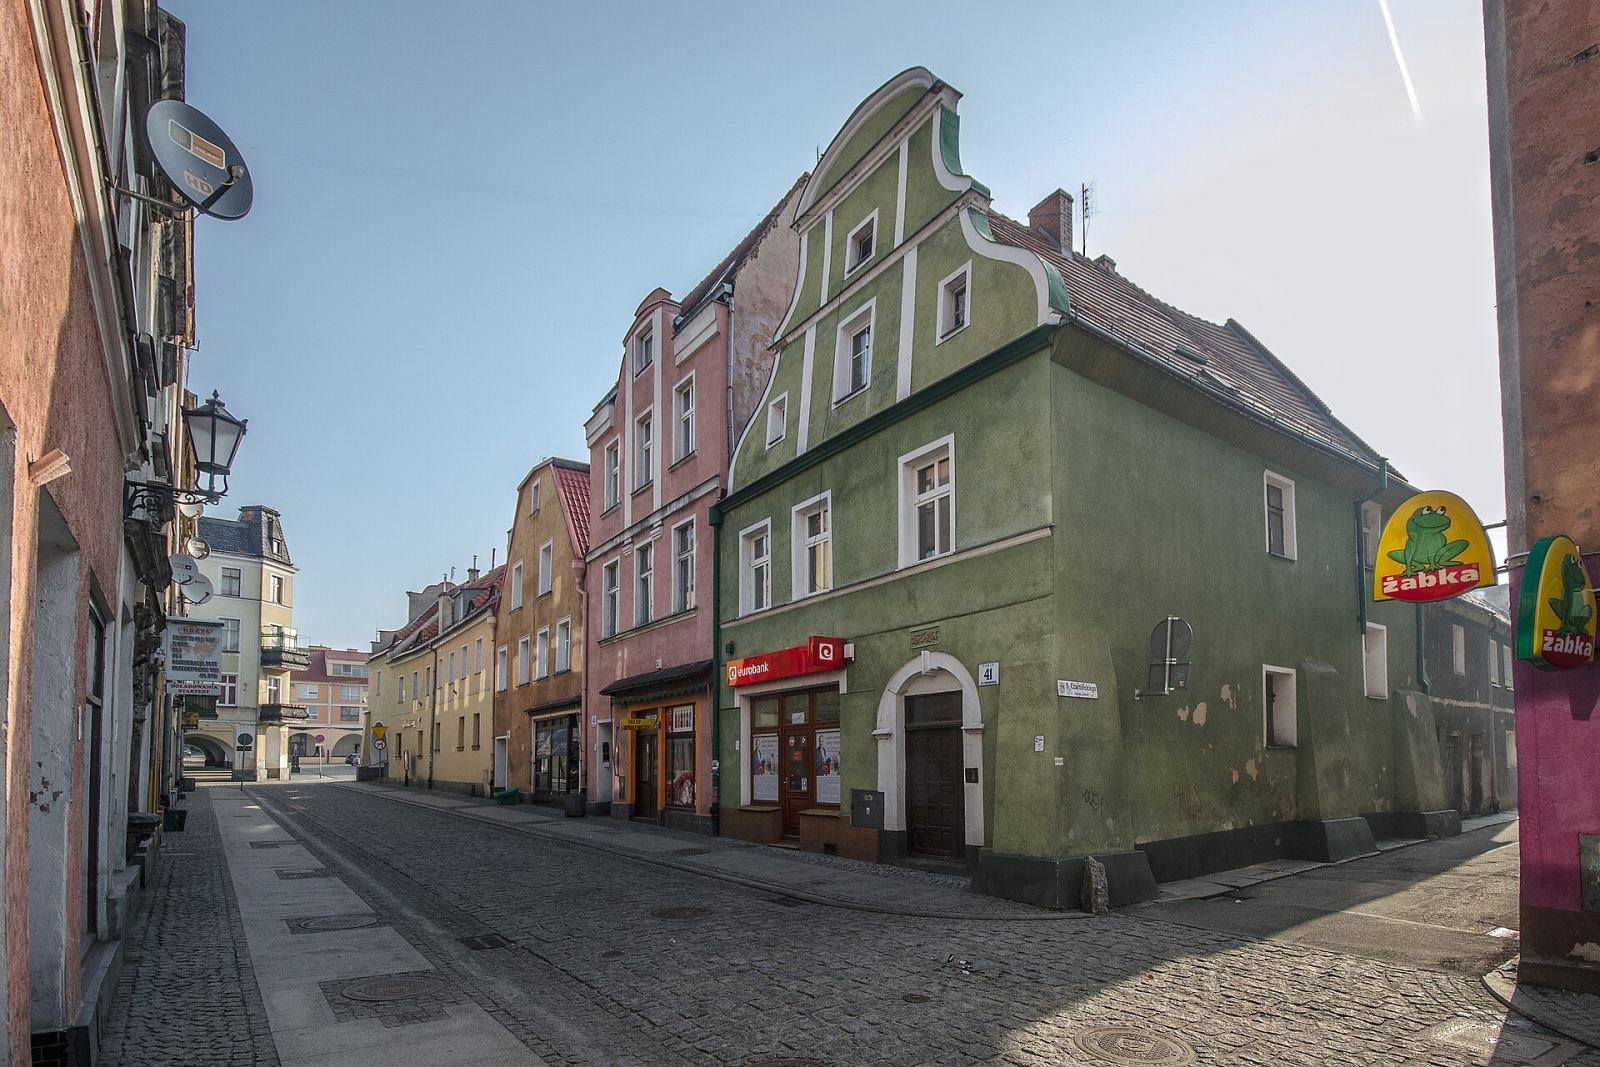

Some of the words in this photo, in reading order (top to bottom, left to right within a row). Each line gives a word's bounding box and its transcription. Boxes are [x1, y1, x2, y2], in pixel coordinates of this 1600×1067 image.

[1383, 567, 1479, 594] żabka
[1543, 631, 1593, 657] żabka
[737, 661, 769, 677] eurobank
[984, 668, 993, 680] 41
